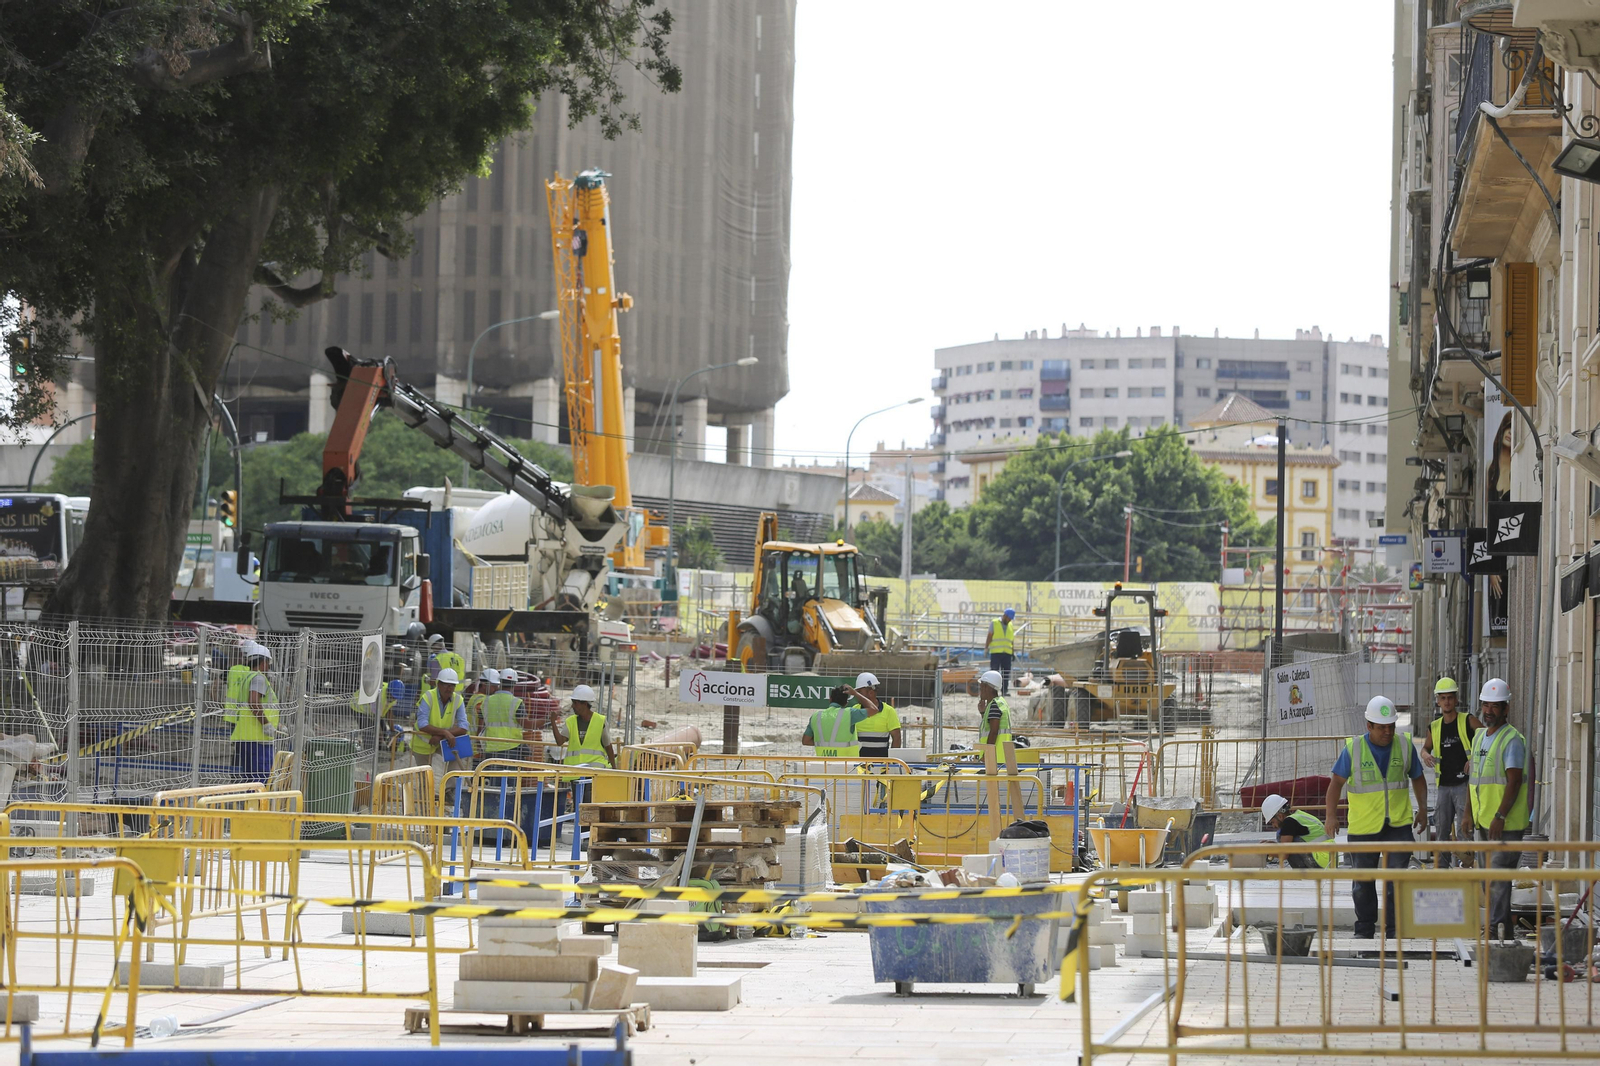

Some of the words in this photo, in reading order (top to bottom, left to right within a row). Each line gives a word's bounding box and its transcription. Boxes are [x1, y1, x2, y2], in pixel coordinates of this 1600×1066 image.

[22, 514, 48, 527] LINE
[310, 592, 340, 600] IVECO
[702, 681, 755, 697] acciona
[779, 684, 855, 701] SAND
[723, 695, 755, 703] Construcción
[1280, 708, 1288, 720] La
